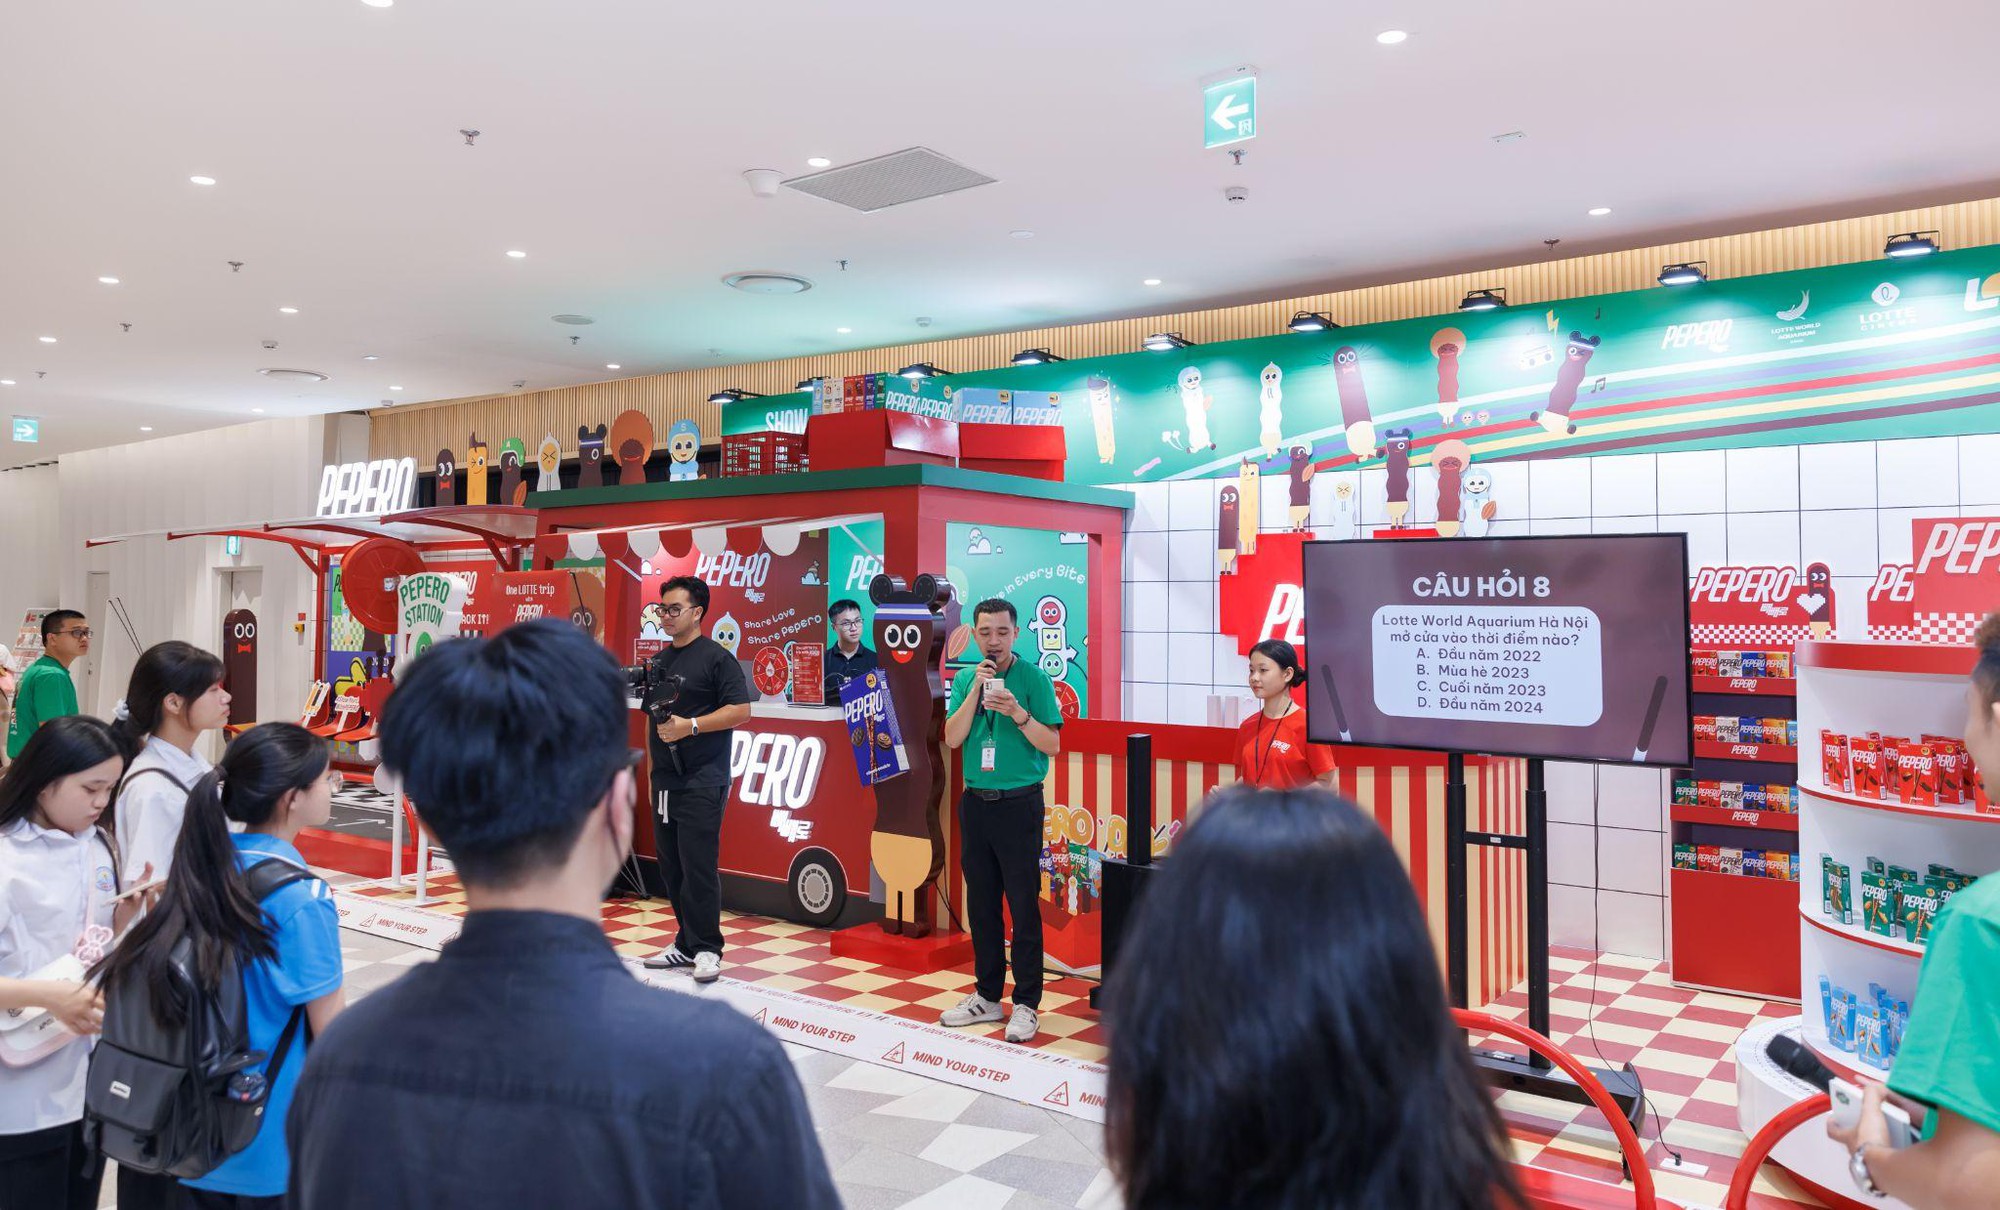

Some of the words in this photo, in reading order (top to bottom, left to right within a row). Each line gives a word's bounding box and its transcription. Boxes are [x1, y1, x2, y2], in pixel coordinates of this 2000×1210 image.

[1859, 306, 1918, 324] LOTTE
[1661, 318, 1733, 350] PEPERO
[1771, 326, 1794, 335] LOTTE
[1795, 322, 1821, 332] WORLD
[886, 391, 921, 414] PEPERO
[920, 396, 953, 420] PEPERO
[765, 407, 808, 435] SHOW
[963, 404, 1012, 425] PEPERO
[1013, 406, 1062, 427] PEPERO
[316, 457, 415, 518] PEPERO
[695, 550, 771, 588] PEPERO
[1014, 568, 1053, 586] Every
[1056, 564, 1086, 585] Bite
[400, 575, 450, 607] PEPERO
[506, 585, 517, 595] One
[518, 585, 537, 595] LOTTE
[539, 583, 555, 597] trip
[1412, 571, 1470, 598] CÂU
[1477, 568, 1525, 598] HỎI
[1533, 576, 1550, 598] 8
[1691, 568, 1796, 603] PEPERO
[405, 602, 444, 628] STATION
[478, 613, 489, 625] IT!
[744, 618, 772, 629] Share
[772, 608, 795, 623] Love
[1382, 614, 1419, 626] Lotte
[1421, 614, 1462, 627] World
[1466, 615, 1535, 631] Aquarium
[1539, 616, 1559, 628] Hà
[1563, 616, 1589, 632] Nội
[747, 632, 781, 645] Share
[781, 614, 822, 637] Pepero
[1390, 630, 1411, 643] mở
[1414, 629, 1439, 643] cửa
[1442, 631, 1468, 644] vào
[1471, 632, 1499, 645] thời
[1503, 631, 1539, 646] điểm
[1542, 633, 1580, 647] nào?
[1416, 647, 1430, 659] A.
[1469, 649, 1499, 661] năm
[1503, 650, 1542, 662] 2022
[1742, 659, 1765, 668] PEPERO
[1416, 664, 1430, 676] B.
[1438, 664, 1467, 677] Mùa
[1471, 665, 1488, 677] hè
[1491, 666, 1530, 679] 2023
[1417, 680, 1431, 692] C.
[1439, 679, 1470, 693] Cuối
[1474, 682, 1504, 695] năm
[1507, 684, 1547, 697] 2023
[1730, 679, 1757, 689] PEPERO
[845, 689, 883, 725] PEPERO
[1417, 696, 1431, 708] D.
[1439, 695, 1467, 709] Đầu
[1470, 699, 1500, 711] năm
[1504, 700, 1543, 714] 2024
[1740, 725, 1763, 734] PEPERO
[1731, 745, 1759, 755] PEPERO
[1852, 749, 1877, 764] PEPERO
[1899, 755, 1932, 770] PEPERO
[1676, 787, 1698, 796] PEPERO
[1698, 788, 1720, 797] PEPERO
[1743, 791, 1766, 800] PEPERO
[1732, 811, 1759, 822] PEPERO
[1674, 851, 1697, 860] PEPERO
[1697, 853, 1720, 863] PEPERO
[1743, 857, 1766, 867] PEPERO
[1862, 883, 1887, 901] PEPERO
[1903, 894, 1937, 911] PEPERO
[377, 918, 395, 928] MIND
[394, 921, 412, 932] YOUR
[410, 925, 428, 935] STEP
[772, 1016, 799, 1030] MIND
[800, 1022, 828, 1037] YOUR
[828, 1030, 856, 1043] STEP
[1857, 1013, 1880, 1033] PEPERO
[967, 1036, 991, 1047] WITH
[991, 1042, 1029, 1056] PEPERO
[912, 1050, 943, 1066] MIND
[945, 1060, 978, 1077] YOUR
[978, 1067, 1010, 1083] STEP
